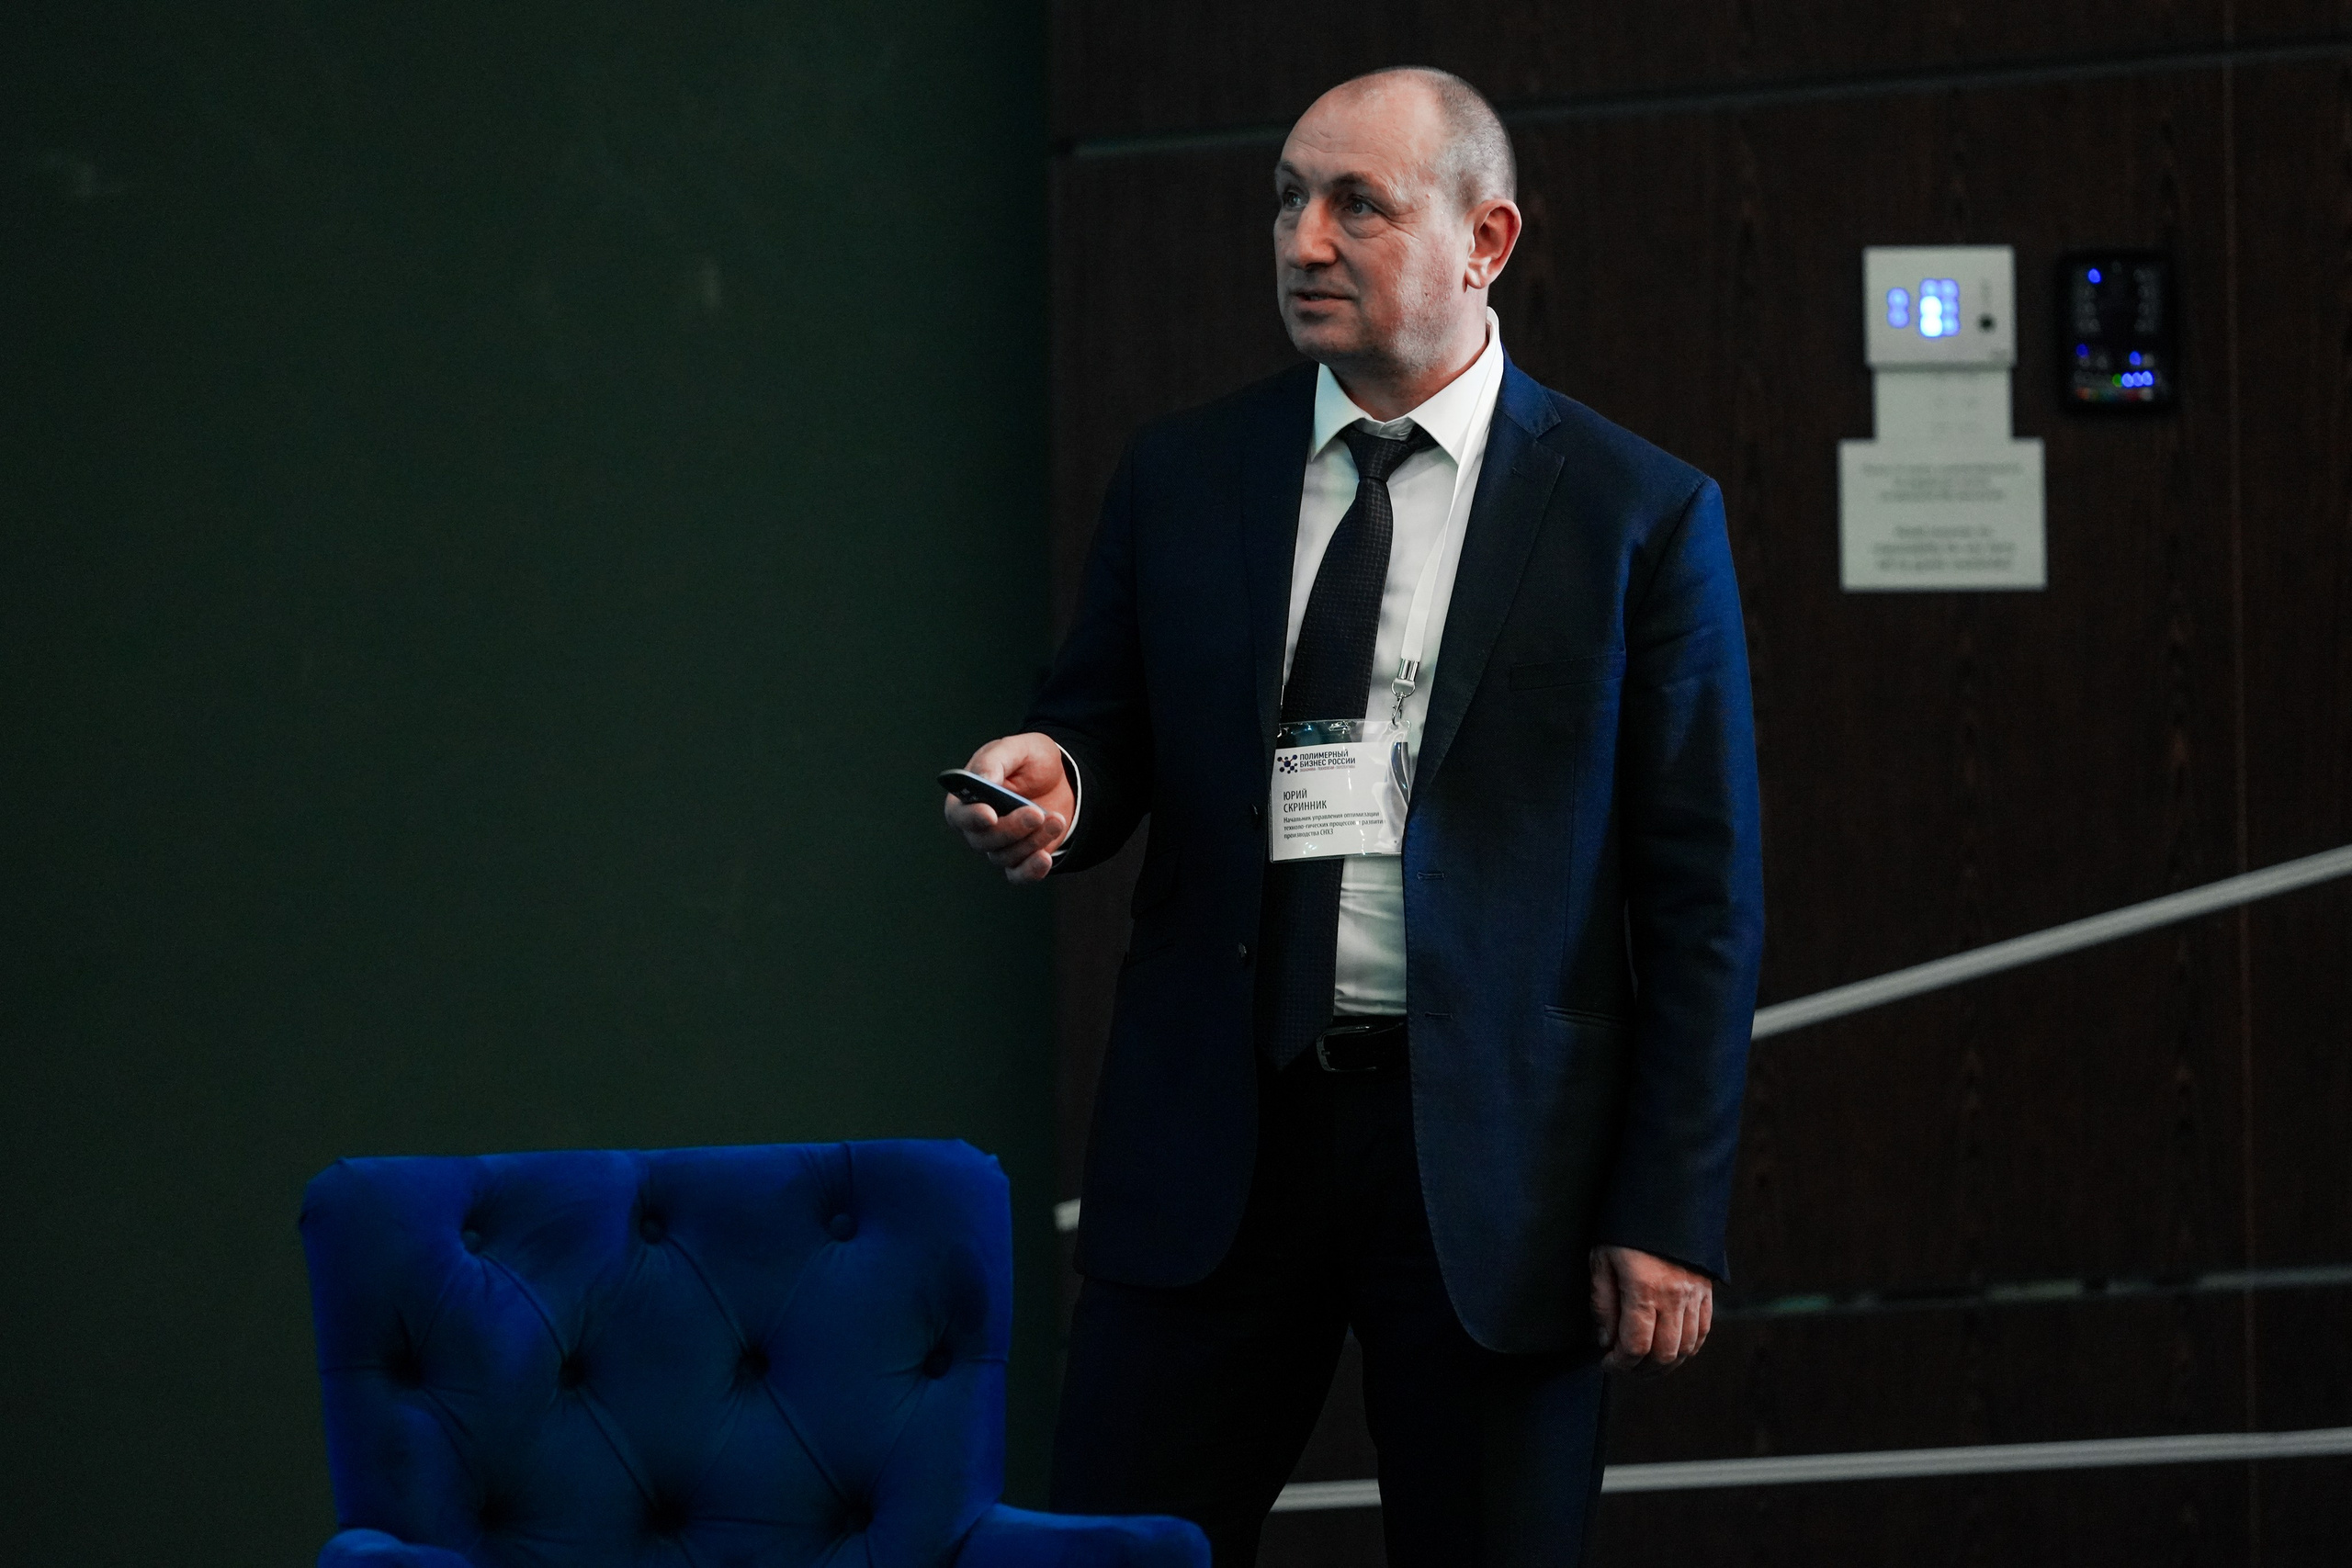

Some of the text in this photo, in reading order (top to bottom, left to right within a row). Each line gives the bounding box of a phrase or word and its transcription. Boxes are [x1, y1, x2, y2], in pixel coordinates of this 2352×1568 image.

[1300, 750, 1349, 761] ПОЛИМЕРНЫЙ
[1283, 788, 1307, 801] ЮРИЙ
[1283, 800, 1327, 813] СКРИННИК
